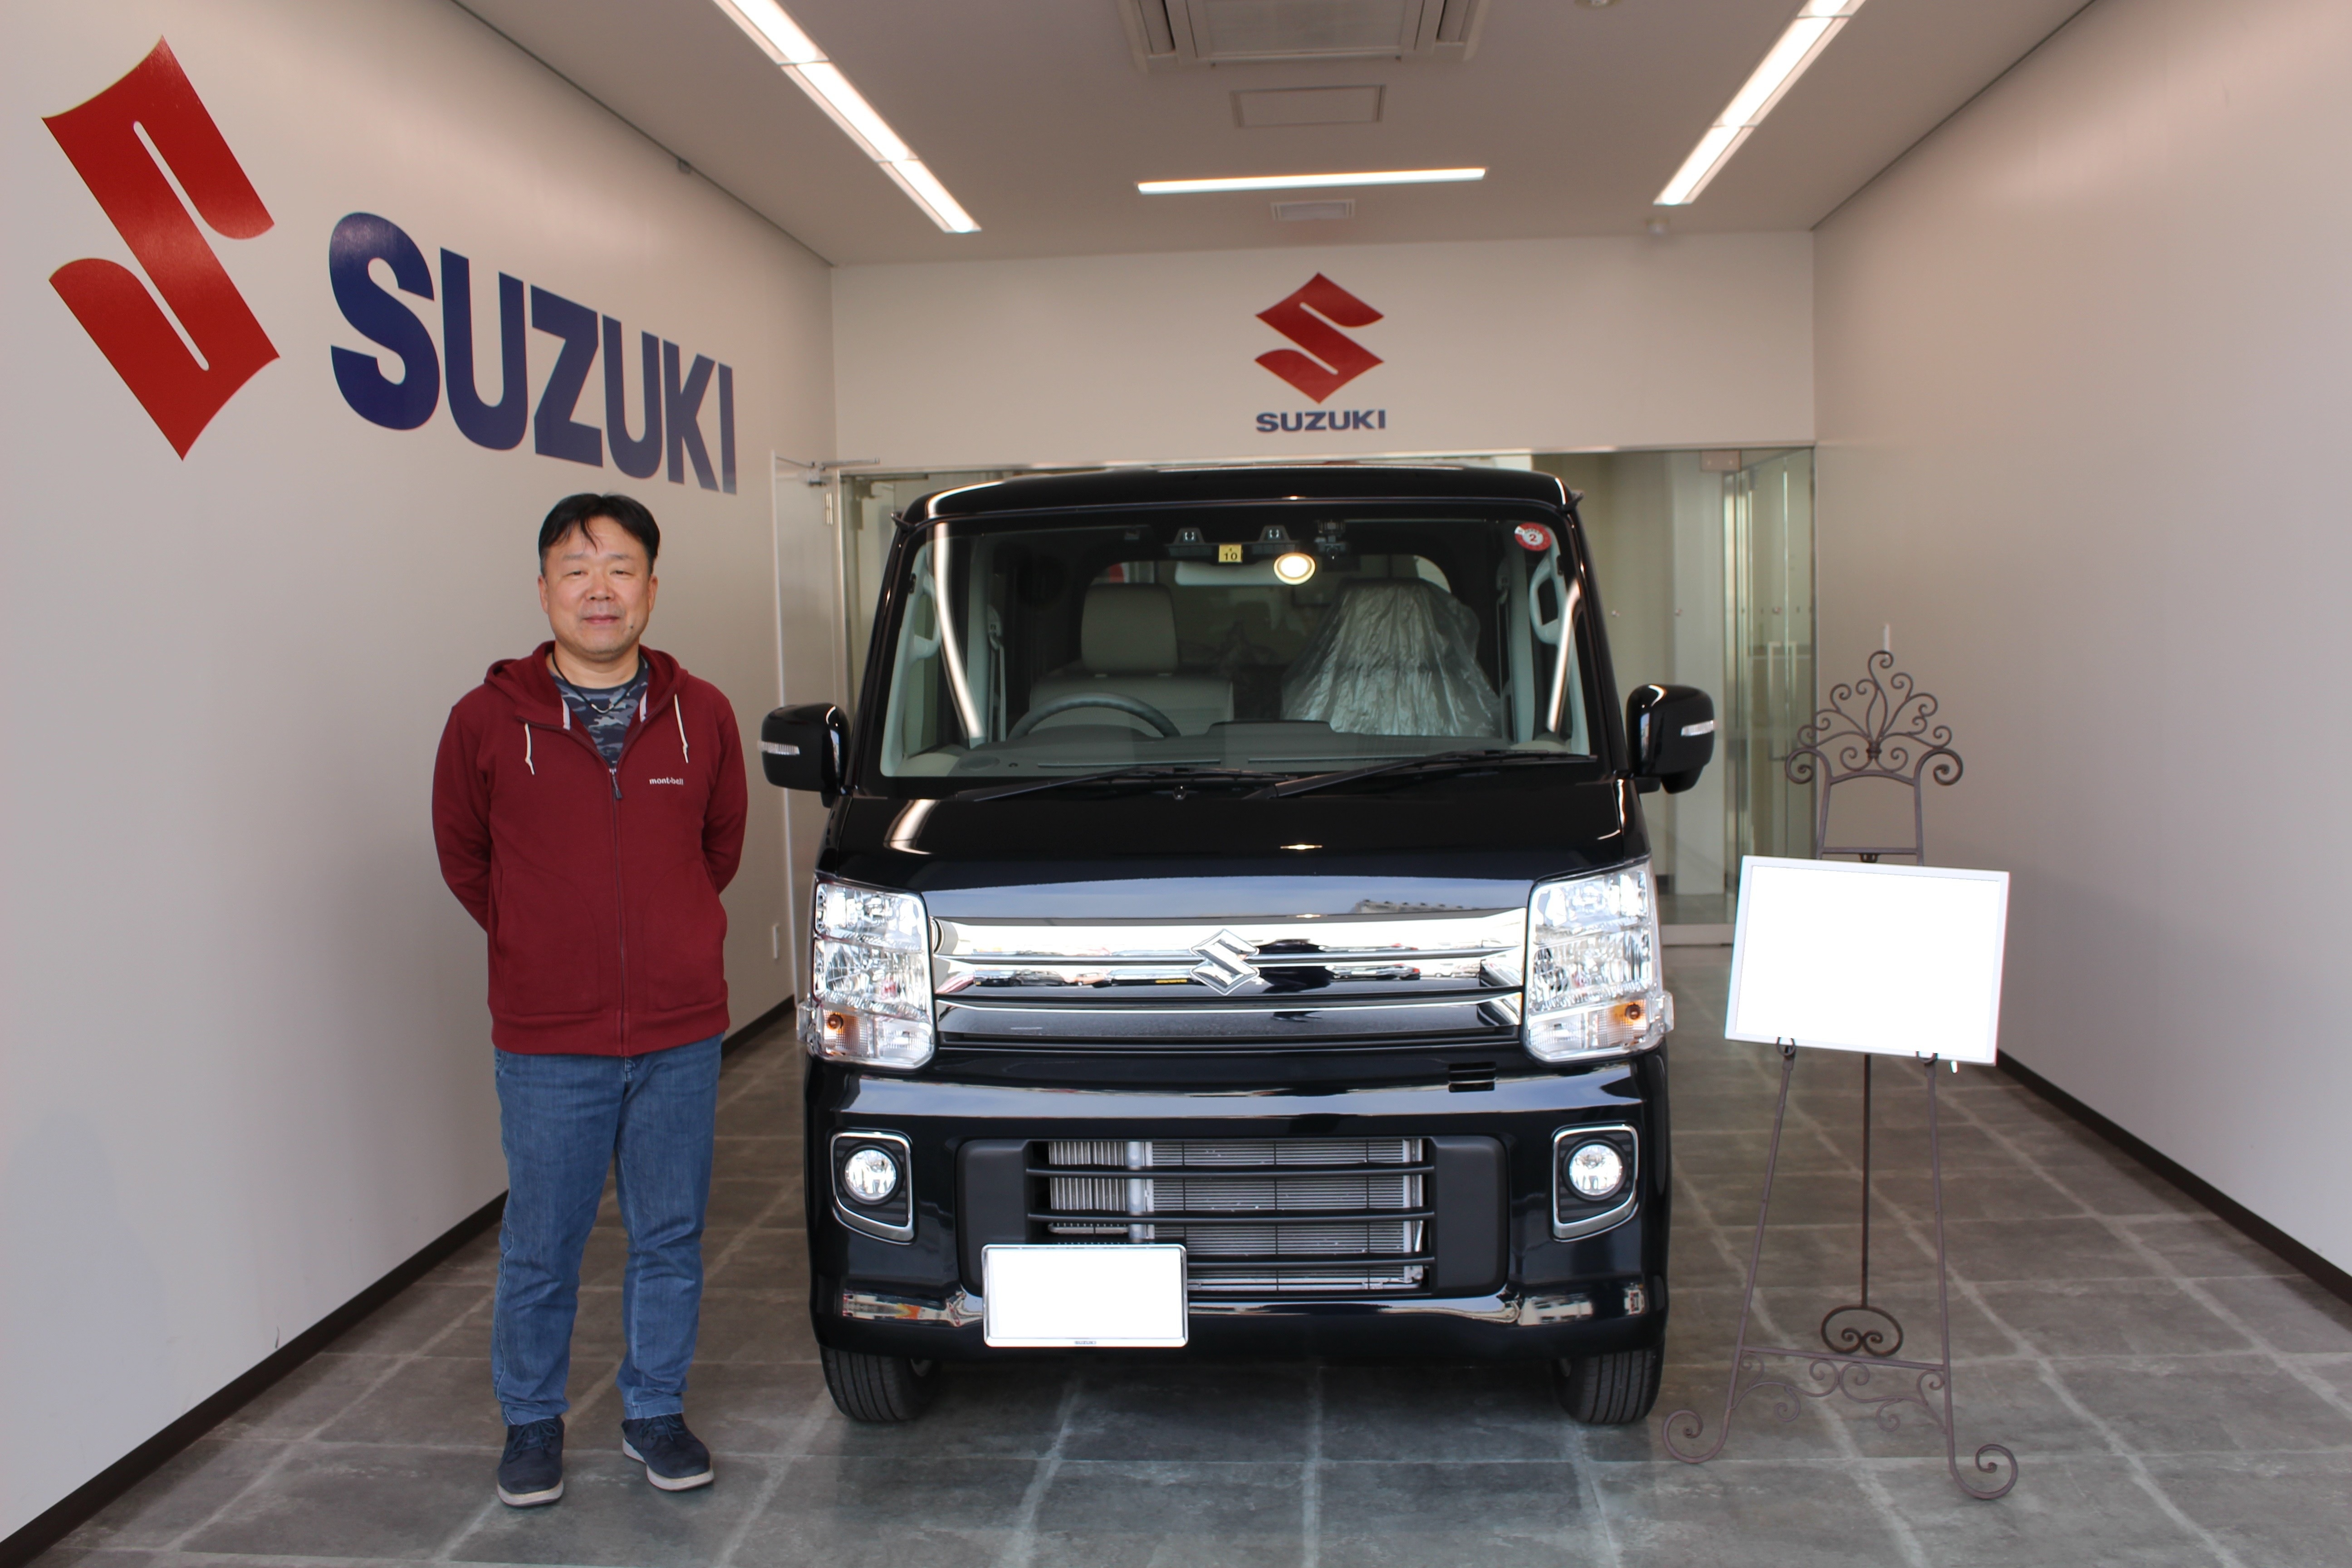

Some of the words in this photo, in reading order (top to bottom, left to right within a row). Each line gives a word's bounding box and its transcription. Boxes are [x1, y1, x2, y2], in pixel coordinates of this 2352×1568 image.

[329, 212, 736, 494] SUZUKI
[1256, 410, 1386, 432] SUZUKI
[1529, 534, 1537, 542] 2
